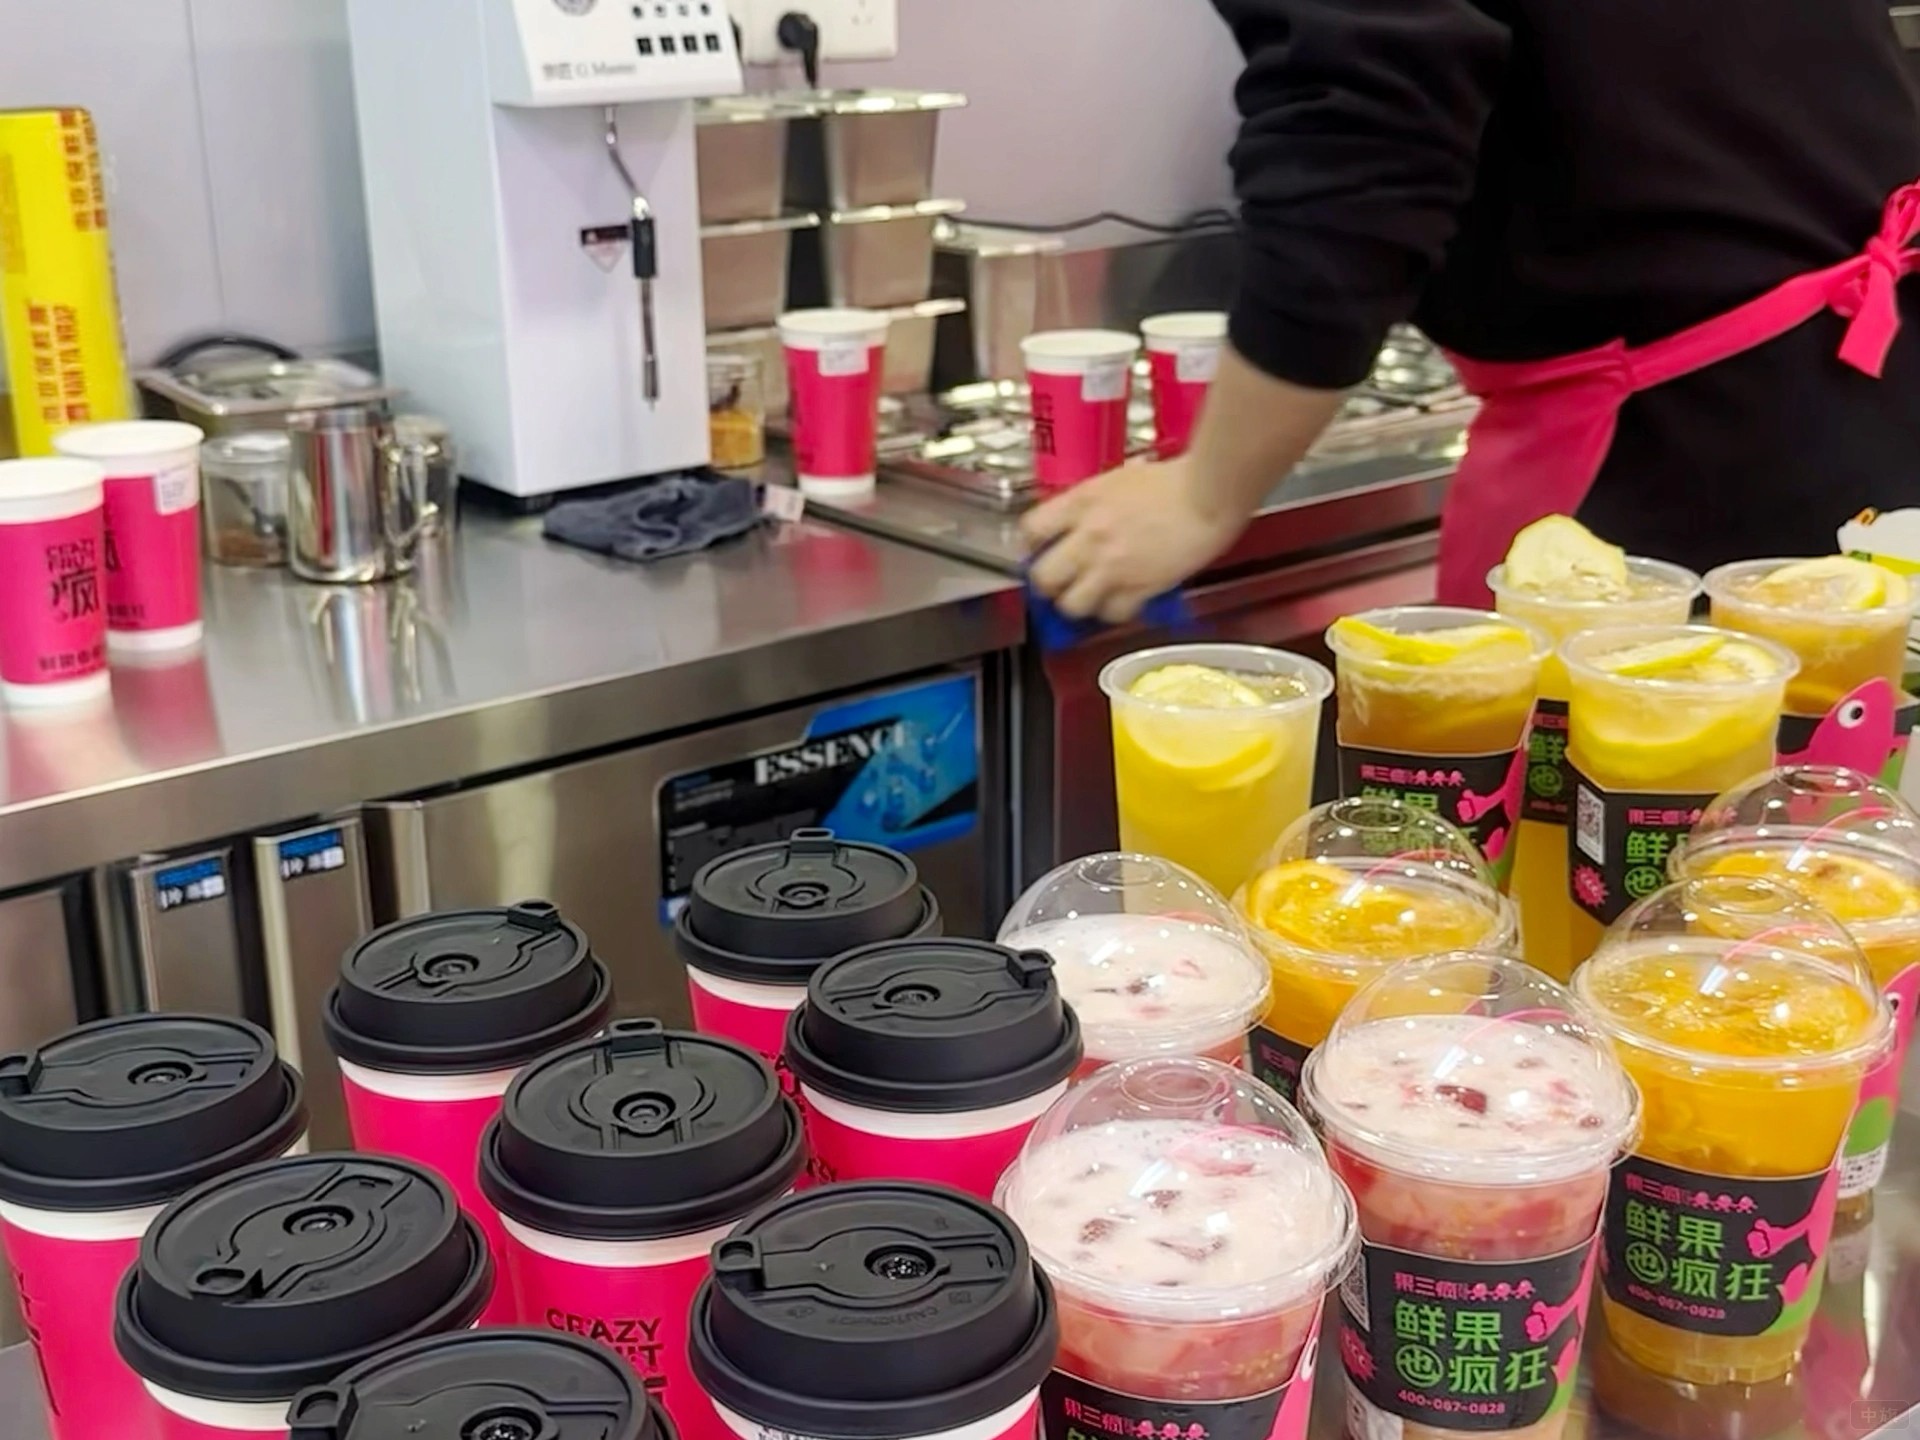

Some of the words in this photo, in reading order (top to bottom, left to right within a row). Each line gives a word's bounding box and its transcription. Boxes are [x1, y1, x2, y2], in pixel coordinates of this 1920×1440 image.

[1625, 1199, 1725, 1258] 鲜果
[1625, 1242, 1773, 1300] 也疯狂
[546, 1307, 662, 1343] CRAZY
[1395, 1299, 1503, 1351] 鲜果
[1395, 1343, 1549, 1394] 也疯狂
